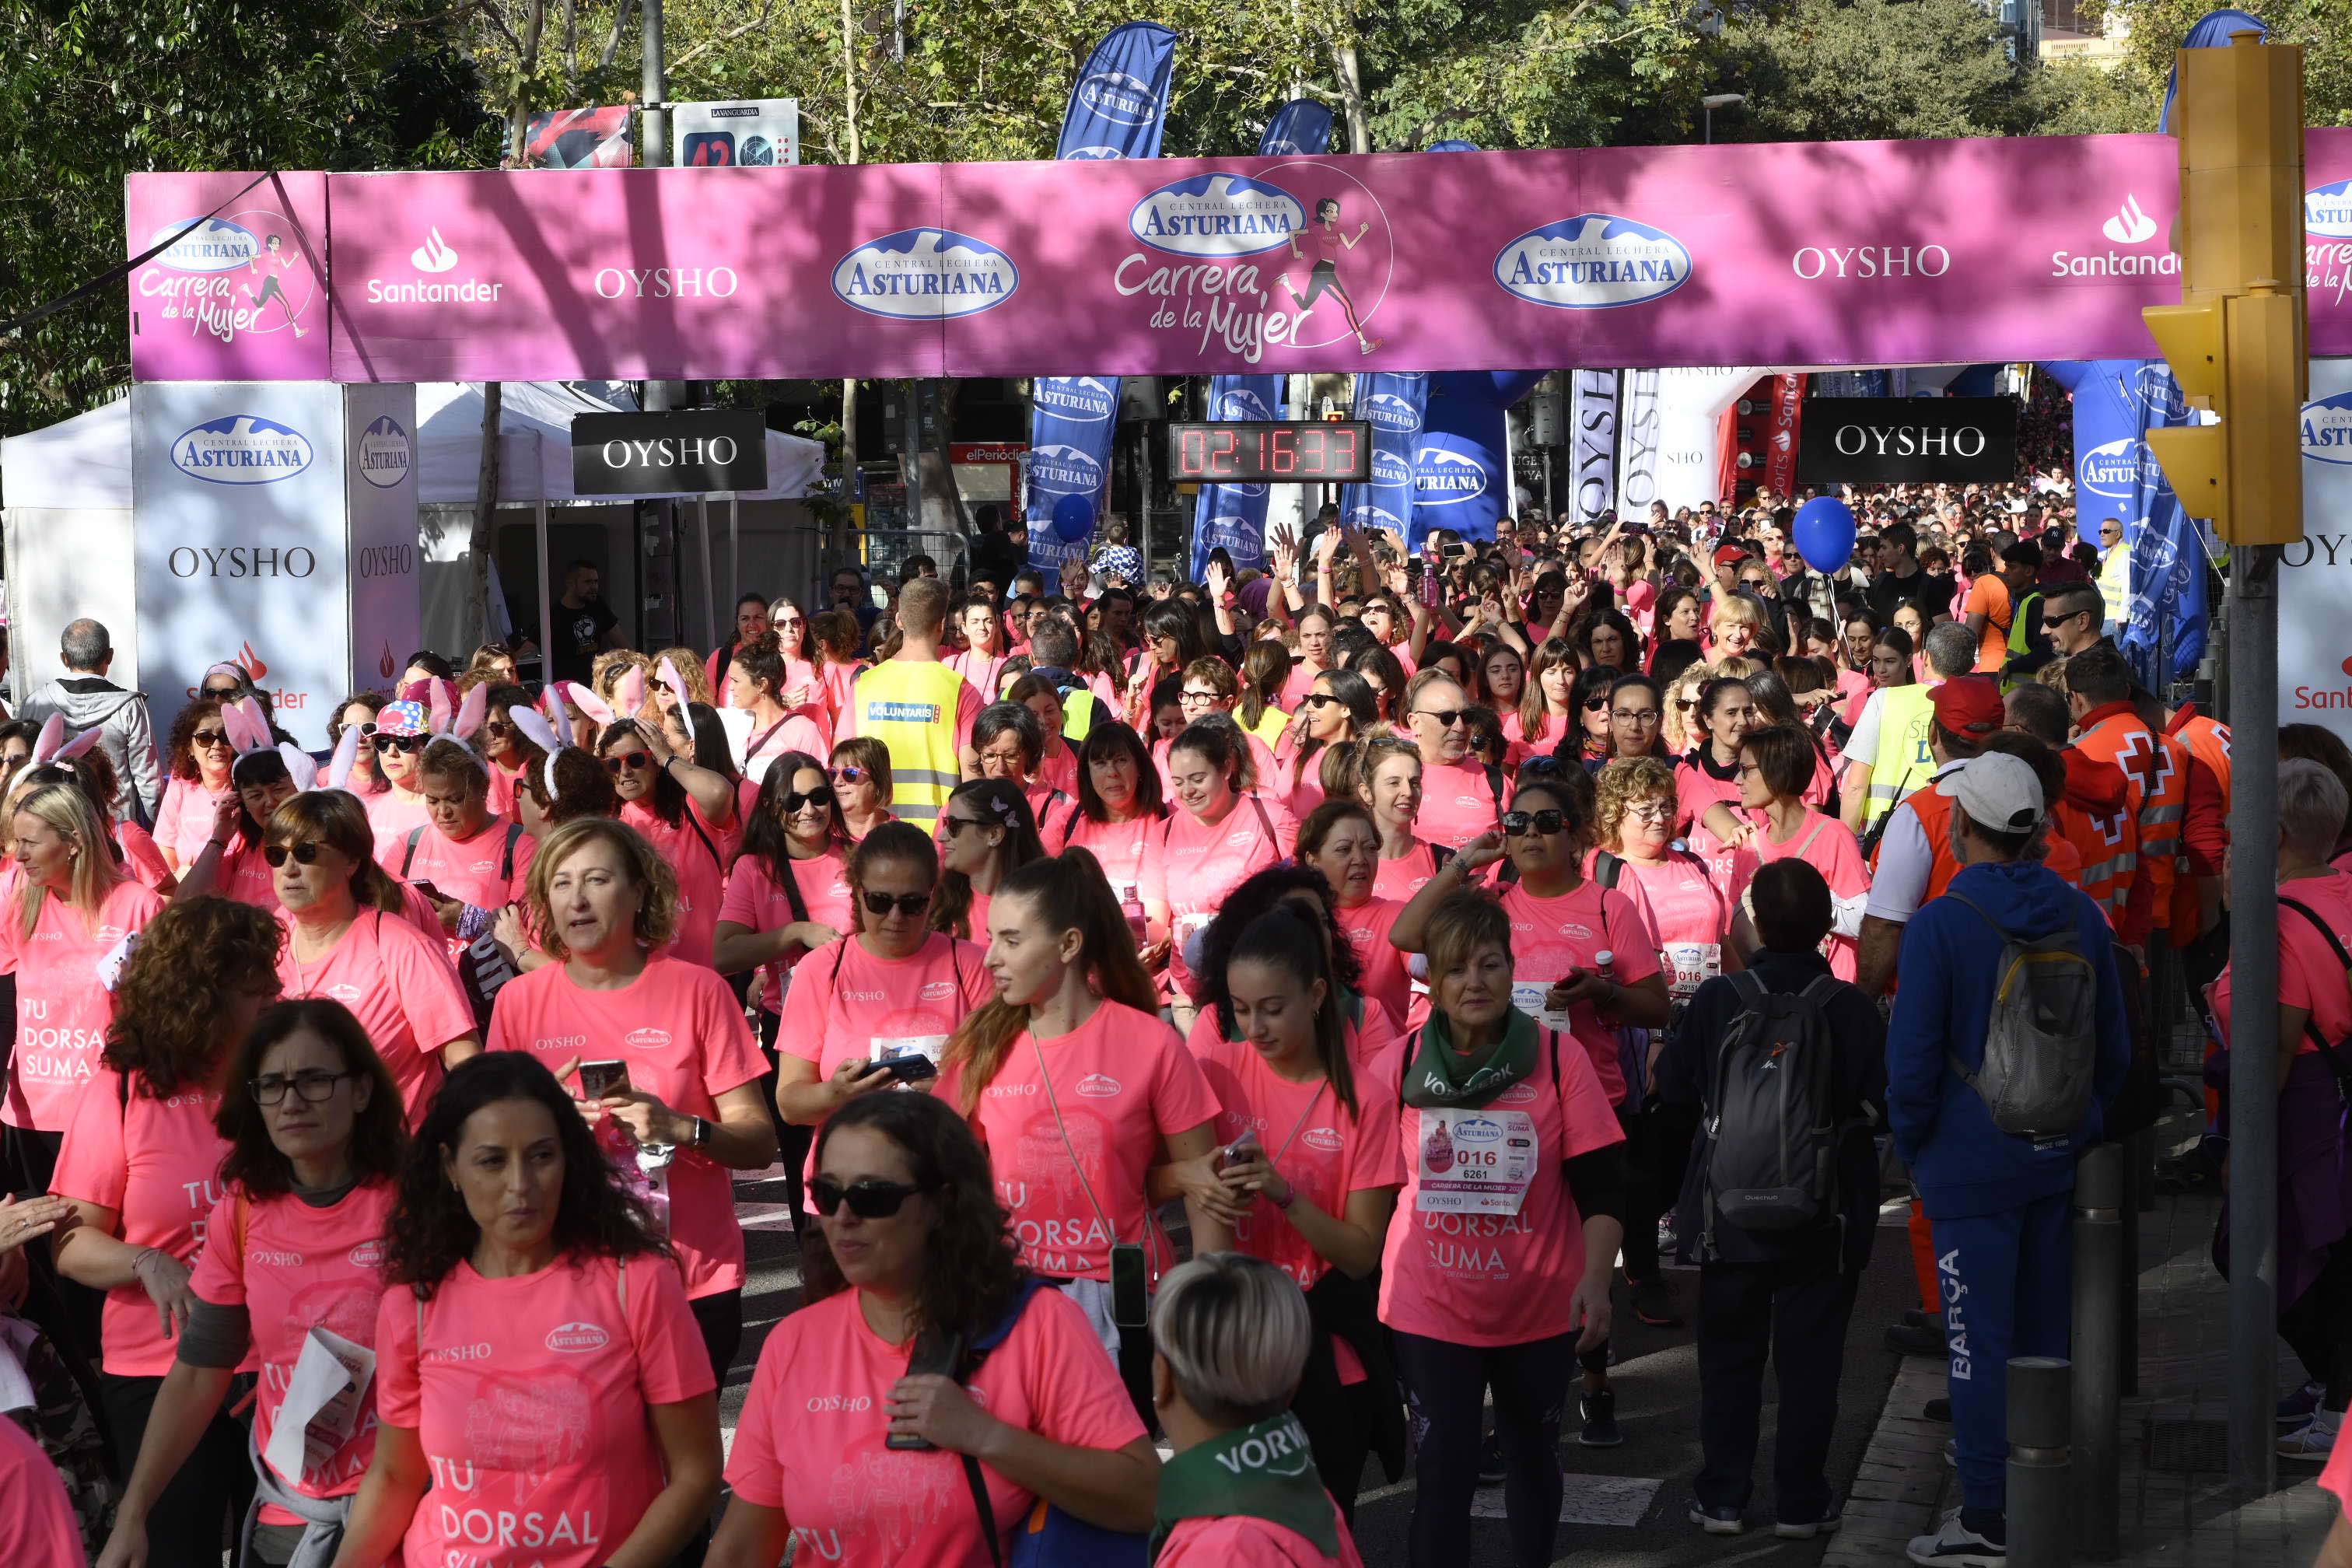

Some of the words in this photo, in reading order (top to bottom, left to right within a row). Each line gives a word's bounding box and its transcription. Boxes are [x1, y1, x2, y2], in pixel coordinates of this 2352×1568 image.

[1084, 83, 1153, 118] ASTURIANA
[1170, 202, 1225, 211] CENTRAL
[1231, 201, 1286, 210] LECHERA
[1143, 205, 1293, 236] ASTURIANA
[939, 259, 997, 268] LECHERA
[1539, 246, 1601, 257] CENTRAL
[1607, 244, 1670, 255] LECHERA
[1792, 244, 1951, 280] OYSHO
[846, 262, 1004, 296] ASTURIANA
[1114, 253, 1260, 296] Carrera
[1509, 250, 1676, 285] ASTURIANA
[2324, 267, 2339, 288] la
[138, 268, 229, 297] Carrera
[367, 278, 502, 303] Santander
[594, 266, 738, 299] OYSHO
[162, 300, 177, 319] de
[182, 299, 195, 319] la
[193, 295, 265, 343] Mujer
[1150, 299, 1177, 329] de
[1183, 297, 1202, 328] la
[1198, 292, 1314, 364] Mujer
[1034, 383, 1108, 414] ASTURIANA
[1046, 383, 1077, 394] CENTRAL
[1181, 430, 1356, 473] 02:16:33
[1579, 369, 1614, 518] OYSH
[1626, 369, 1659, 507] OYSH
[1835, 425, 1986, 457] OYSHO
[182, 440, 303, 467] ASTURIANA
[362, 443, 408, 470] ASTURIANA
[602, 436, 738, 469] OYSHO
[1031, 465, 1097, 487] STURIANA
[1416, 475, 1479, 490] URIANA
[1203, 527, 1259, 555] ASTURIANA
[169, 546, 316, 578] OYSHO
[360, 544, 411, 579] OYSHO
[870, 705, 932, 717] VOLUNTARIS
[1678, 971, 1701, 982] 016
[24, 998, 47, 1020] TU
[842, 991, 884, 1002] OYSHO
[24, 1027, 106, 1049] DORSA
[535, 1035, 586, 1050] OYSHO
[629, 1035, 669, 1045] ASTURIANA
[26, 1055, 92, 1078] SUMA
[985, 1083, 1037, 1098] OYSHO
[1455, 1126, 1500, 1138] ASTURIANA
[1457, 1150, 1497, 1166] 016
[1463, 1169, 1488, 1180] 6261
[1427, 1195, 1462, 1206] OYSHO
[1425, 1210, 1534, 1237] DORSAL
[251, 1250, 303, 1268] OYSHO
[1938, 1248, 1972, 1381] BARÇA
[551, 1333, 604, 1347] ASTURIANA
[807, 1394, 872, 1412] OYSHO
[430, 1455, 474, 1492] TU
[441, 1505, 599, 1548] DORSAL
[796, 1527, 842, 1561] TU
